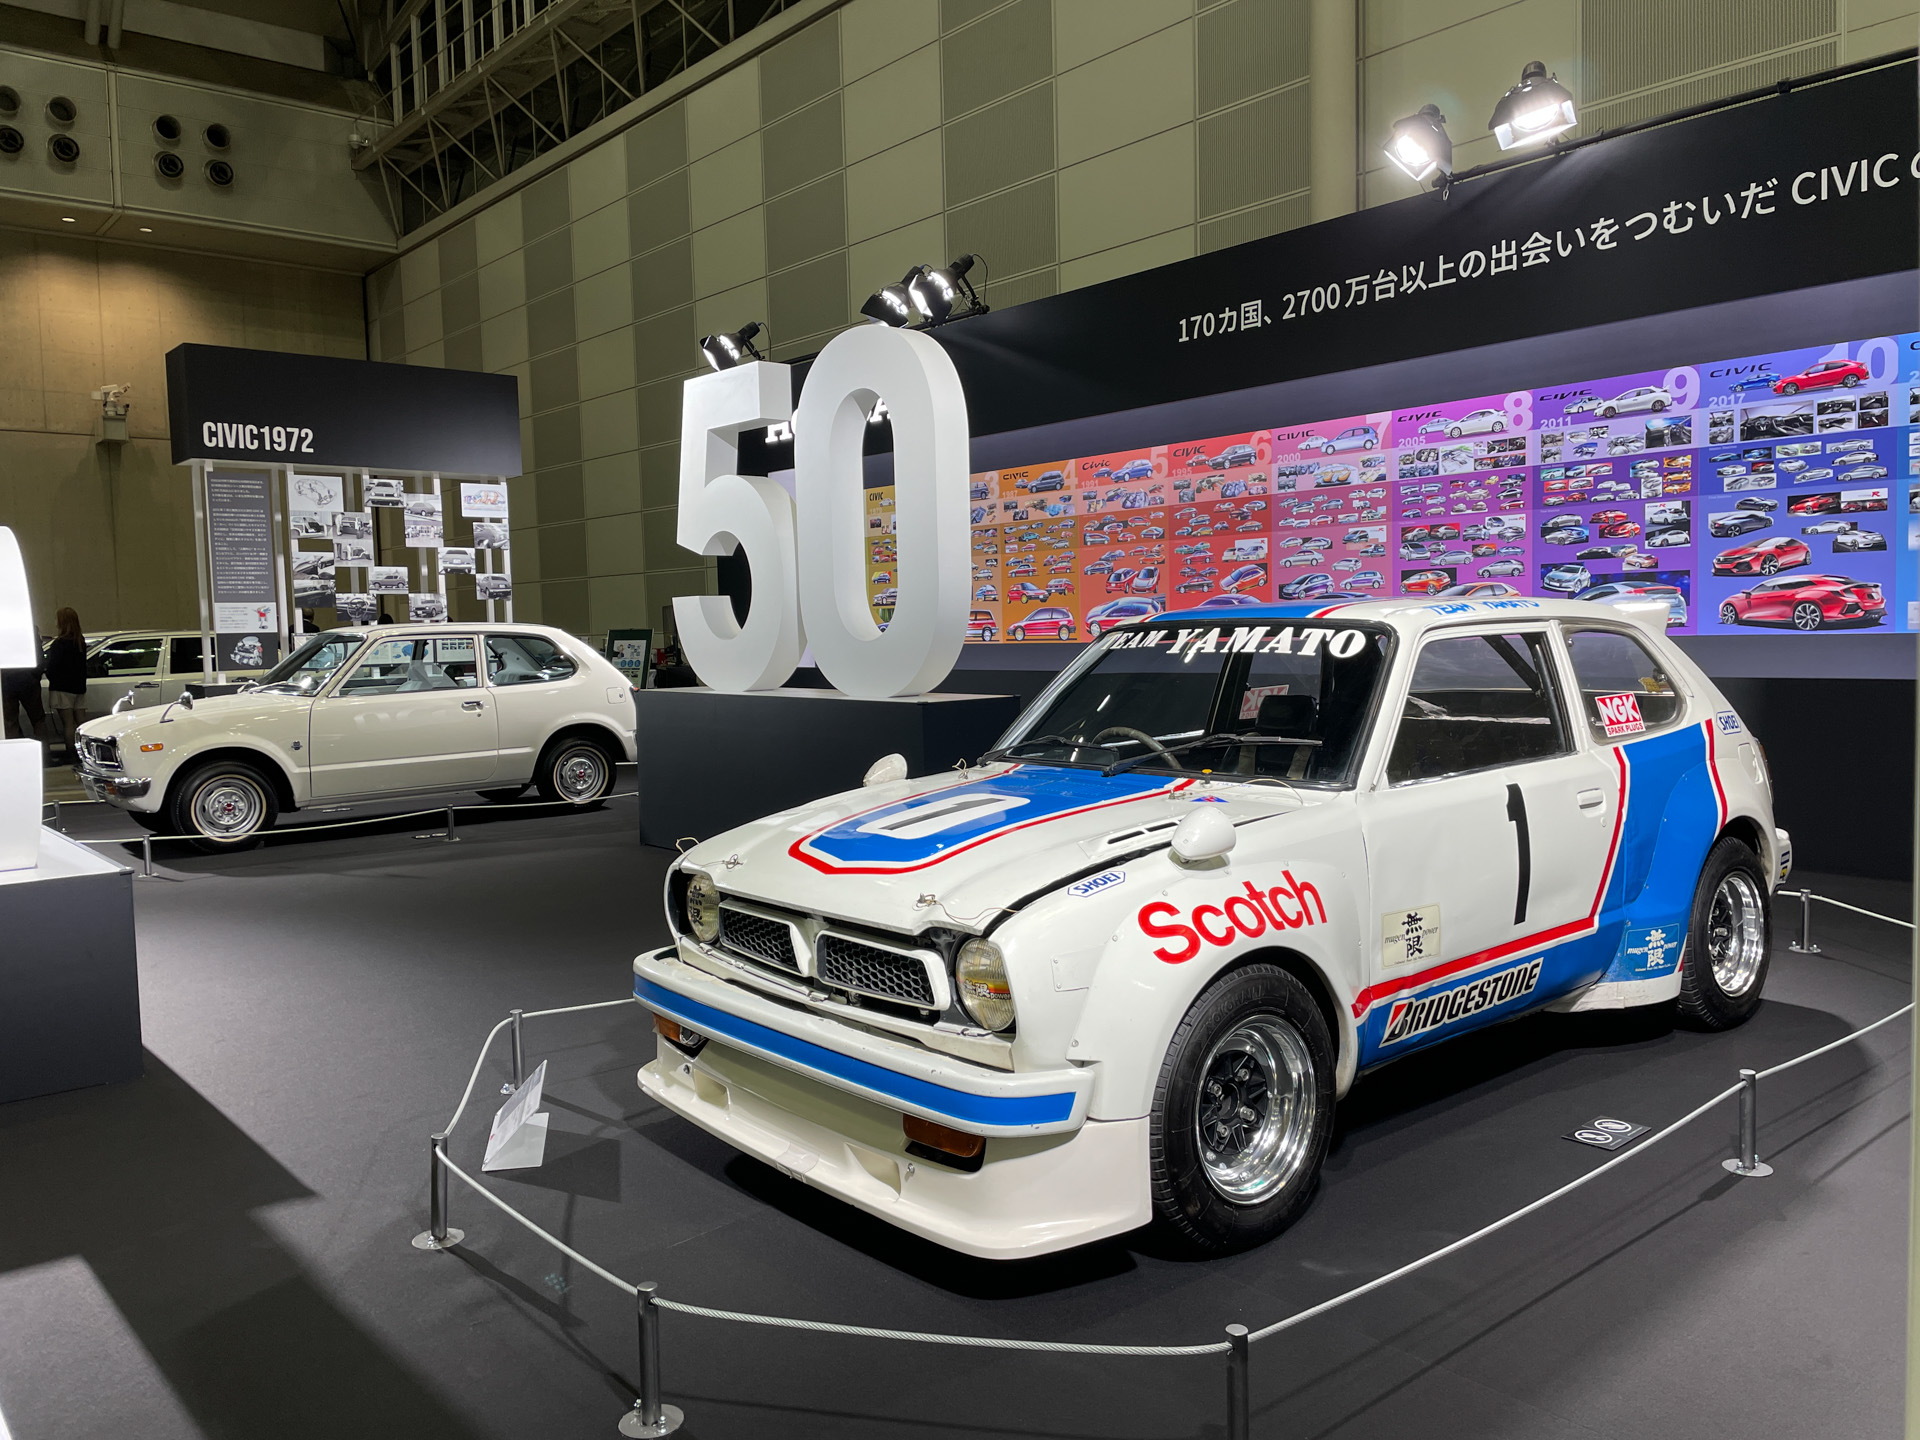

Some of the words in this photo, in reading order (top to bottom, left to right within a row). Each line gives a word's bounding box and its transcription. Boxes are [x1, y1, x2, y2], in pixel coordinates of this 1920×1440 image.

[1791, 153, 1900, 205] CIVIC
[1709, 362, 1773, 378] CIVIC
[1818, 337, 1899, 390] 10
[1539, 389, 1592, 401] CIVIC
[1663, 366, 1701, 411] 9
[1708, 392, 1745, 408] 2017
[1397, 410, 1442, 422] CIVIC
[1504, 390, 1534, 433] 8
[1540, 416, 1572, 430] 2011
[202, 421, 314, 454] CIVIC1972
[1277, 430, 1315, 441] CIVIC
[1366, 411, 1392, 450] 7
[1398, 436, 1426, 448] 2005
[1173, 445, 1206, 457] CIVIC
[1250, 429, 1272, 465] 6
[1277, 452, 1301, 464] 2000
[1002, 471, 1029, 480] CIVIC
[1063, 459, 1079, 492] 4
[1082, 459, 1111, 471] Civic
[1172, 467, 1192, 477] 1995
[869, 492, 883, 501] CIVIC
[984, 471, 1000, 500] 3
[1081, 480, 1099, 489] 1991
[672, 324, 970, 698] 50
[1422, 603, 1476, 615] TEAM
[1101, 630, 1168, 650] TEAM
[1166, 626, 1366, 658] YAMATO
[1597, 694, 1641, 725] NGK
[1607, 726, 1626, 736] SPARK
[1626, 722, 1644, 733] PLUGS
[1718, 715, 1740, 731] SHOEI
[878, 797, 1007, 831] 1
[1506, 783, 1531, 925] 1
[1074, 871, 1122, 895] SHOEI
[1138, 870, 1327, 965] Scotch
[1401, 911, 1423, 958] 無限
[1645, 929, 1666, 968] 無限
[1382, 962, 1541, 1044] BRIDGESTONE
